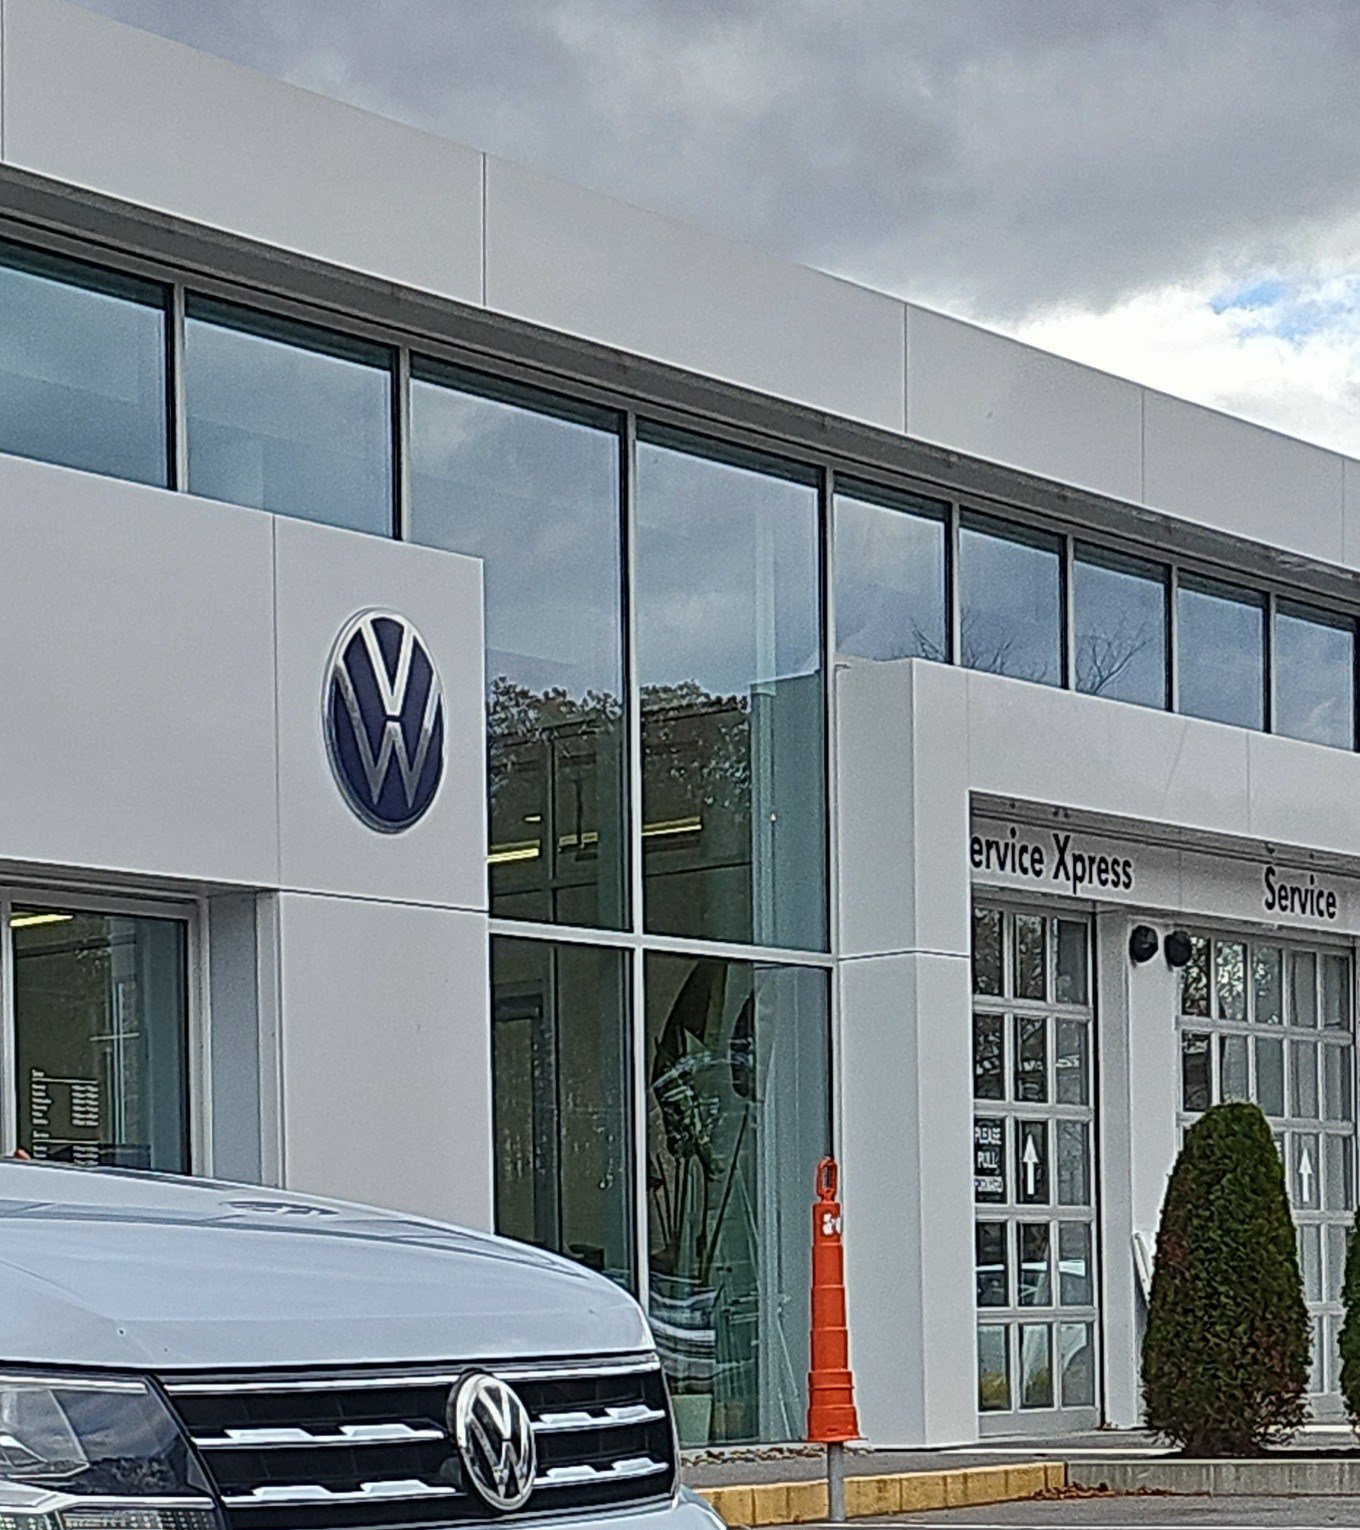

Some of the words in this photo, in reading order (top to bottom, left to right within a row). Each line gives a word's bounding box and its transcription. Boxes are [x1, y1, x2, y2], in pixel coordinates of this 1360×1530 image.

[970, 827, 1044, 878] ervice
[1052, 833, 1133, 894] Xpress
[1263, 866, 1337, 919] Service
